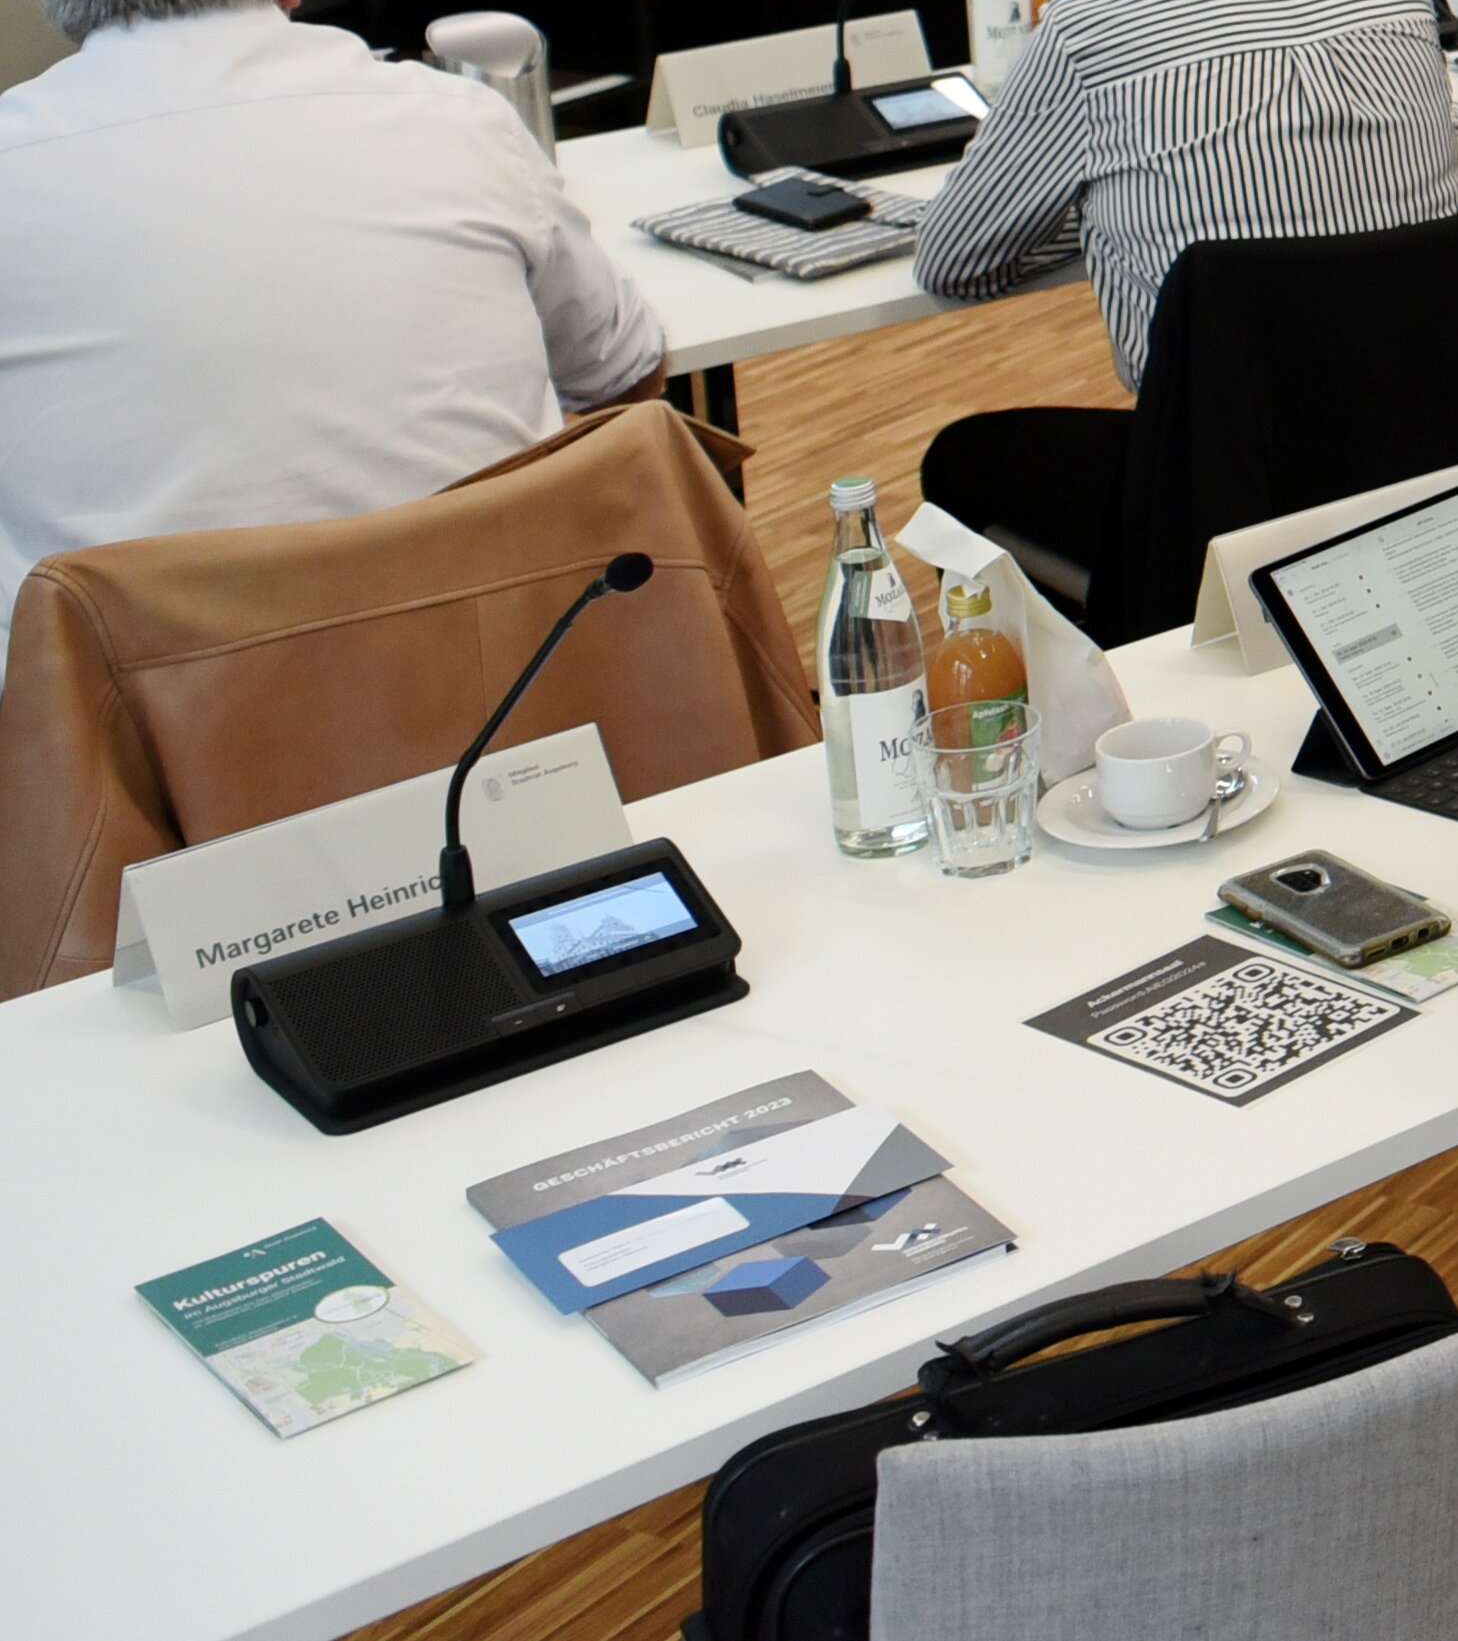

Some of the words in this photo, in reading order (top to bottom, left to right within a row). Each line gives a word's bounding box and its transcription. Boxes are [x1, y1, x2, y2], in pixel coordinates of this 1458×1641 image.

[195, 908, 342, 969] Margarete
[346, 872, 444, 919] Heinric
[532, 1114, 742, 1193] GESCHÄFTSBERICHT
[744, 1096, 794, 1121] 2023
[173, 1249, 327, 1311] Kulturspuren
[204, 1282, 280, 1315] Augsburger
[281, 1255, 347, 1287] Stadtwald
